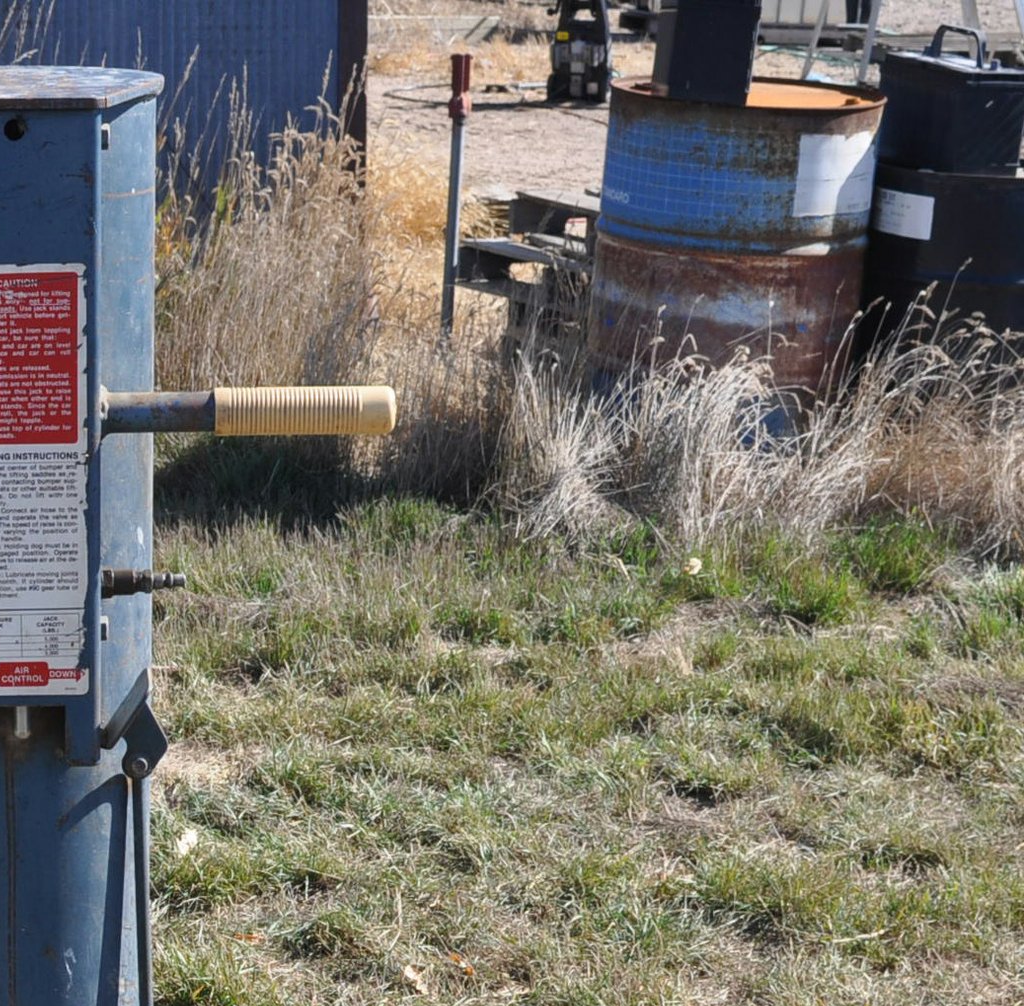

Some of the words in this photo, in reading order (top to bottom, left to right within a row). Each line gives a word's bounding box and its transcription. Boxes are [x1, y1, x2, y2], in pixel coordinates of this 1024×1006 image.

[13, 452, 78, 461] INSTRUCTIONS
[14, 666, 29, 674] AIR
[50, 670, 76, 678] DOWN
[1, 675, 44, 683] CONTROL
